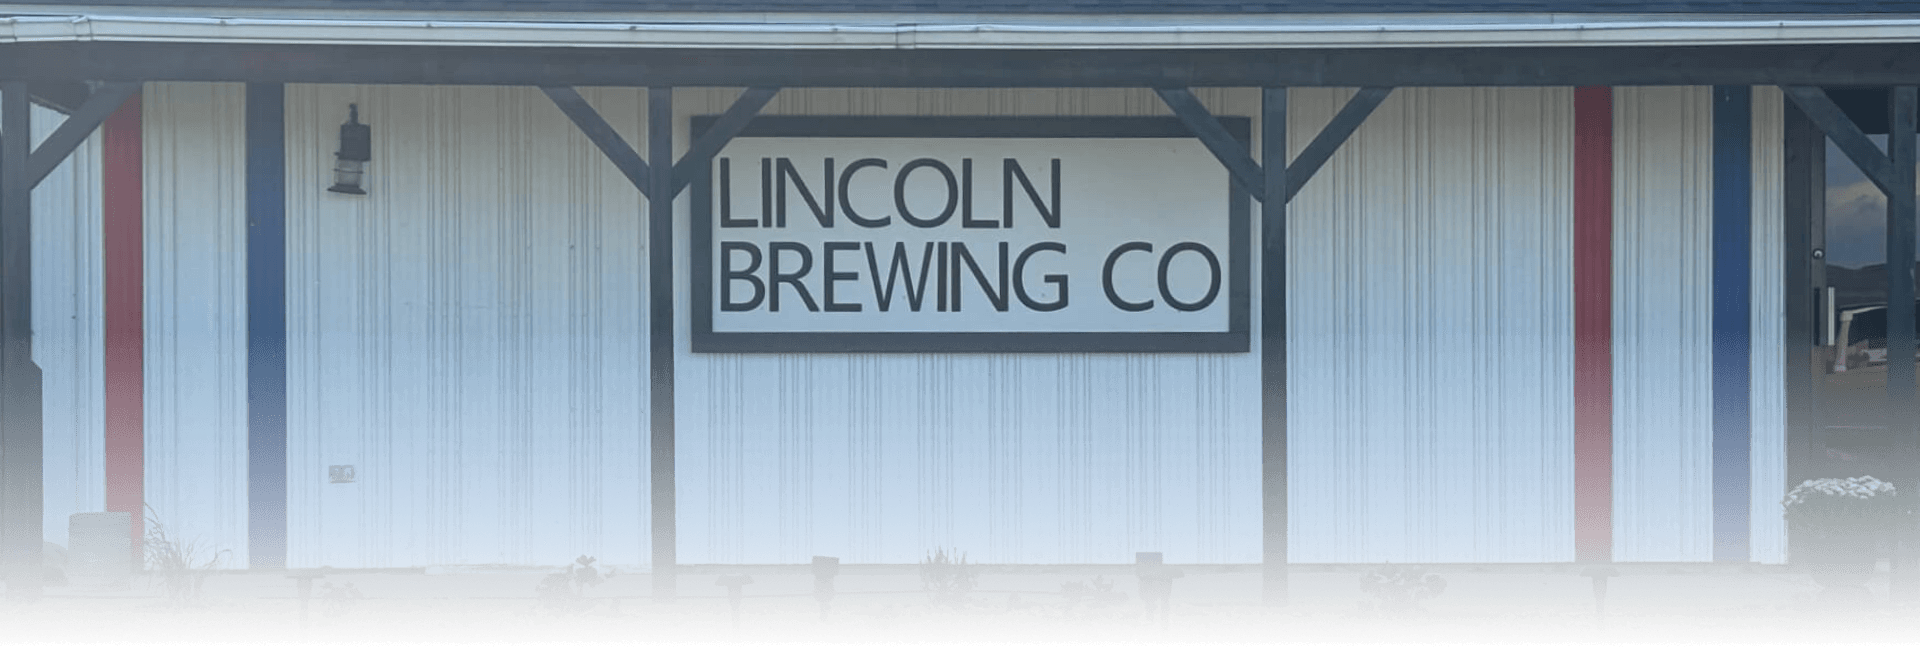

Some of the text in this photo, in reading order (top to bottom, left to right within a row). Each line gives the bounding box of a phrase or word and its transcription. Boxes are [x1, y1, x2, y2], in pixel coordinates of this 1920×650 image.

[719, 157, 1061, 229] LINCOLN
[719, 241, 1222, 313] BREWING CO
